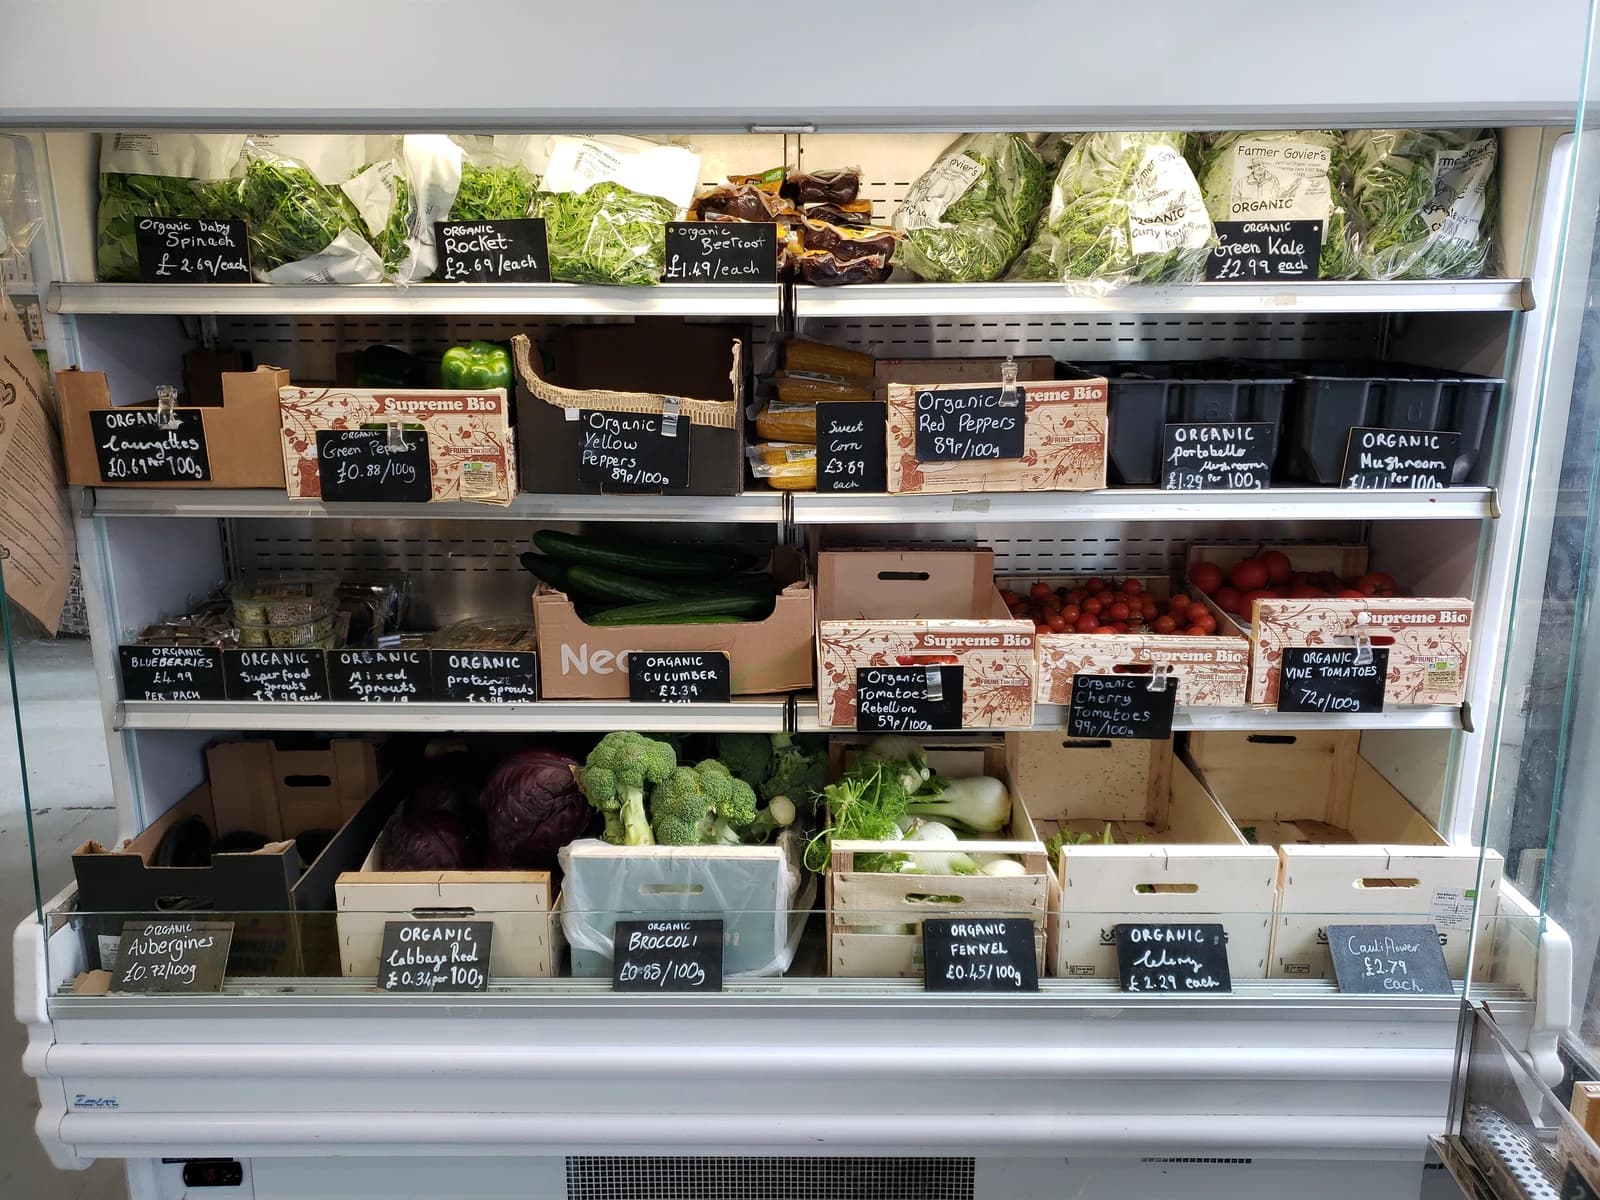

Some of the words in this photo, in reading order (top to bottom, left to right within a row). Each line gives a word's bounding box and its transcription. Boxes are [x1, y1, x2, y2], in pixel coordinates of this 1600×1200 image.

[1238, 145, 1280, 157] Farmer
[1284, 147, 1327, 161] Govier's
[1232, 198, 1294, 213] ORGANIC
[139, 219, 192, 236] Organic
[198, 220, 230, 236] baby
[443, 225, 494, 237] ORGANIC
[678, 225, 730, 241] organic
[1243, 222, 1291, 233] ORGANIC
[166, 231, 236, 249] Spinach
[1214, 234, 1262, 257] Green
[1268, 235, 1305, 255] Kale
[1216, 258, 1270, 279] £2.99
[1278, 259, 1309, 274] each
[1073, 386, 1103, 400] Bio
[384, 398, 463, 412] Supreme
[467, 397, 497, 411] Bio
[918, 392, 996, 414] Organic
[589, 412, 656, 435] Organic
[828, 420, 864, 434] Sweet
[919, 413, 945, 433] Red
[958, 413, 1016, 434] Peppers
[583, 431, 638, 450] Yellow
[1175, 426, 1254, 442] ORGANIC
[1362, 432, 1440, 449] ORGANIC
[322, 439, 361, 459] Green
[829, 440, 863, 453] Corn
[934, 436, 1000, 459] 89p/100g
[582, 450, 636, 469] Peppers
[1360, 452, 1447, 471] Mushroom
[108, 457, 148, 478] £0.69
[166, 456, 202, 479] 100g
[336, 459, 416, 484] £0.88/100g
[611, 467, 669, 485] 89p/100g
[1166, 471, 1203, 489] £1.29
[833, 480, 859, 489] each
[1439, 611, 1468, 623] Bio
[923, 634, 999, 648] Supreme
[1002, 634, 1032, 647] Bio
[152, 648, 205, 658] ORGANIC
[241, 652, 310, 666] ORGANIC
[340, 651, 420, 664] ORGANIC
[1139, 648, 1213, 662] Supreme
[1215, 649, 1243, 662] Bio
[1303, 652, 1352, 665] ORGANIC
[131, 657, 214, 668] BLUEBERRIES
[449, 655, 521, 669] ORGANIC
[646, 656, 704, 668] ORGANIC
[153, 671, 192, 684] £4.99
[349, 668, 407, 682] Mixed
[643, 670, 718, 682] CUCUMBER
[867, 671, 926, 686] Organic
[1285, 667, 1312, 679] VINE
[1319, 665, 1377, 677] TOMATOES
[349, 681, 416, 695] Sprouts
[1077, 676, 1136, 689] Organic
[145, 690, 166, 701] PER
[659, 685, 699, 697] £2.39
[858, 687, 928, 700] Tomatoes
[1075, 690, 1132, 706] Cherry
[861, 701, 917, 714] Rebellion
[1300, 688, 1360, 712] 72p/100g
[1074, 707, 1150, 721] Tomatoes
[143, 924, 193, 936] ORGANIC
[400, 927, 473, 942] ORGANIC
[647, 922, 693, 932] ORGANIC
[950, 923, 1006, 937] ORGANIC
[1130, 928, 1205, 943] ORGANIC
[128, 935, 214, 962] Aubergines
[950, 942, 1008, 957] FENNEL
[1348, 935, 1421, 956] Cauliflower
[386, 946, 447, 973] Cabbage
[450, 941, 478, 963] Red
[122, 961, 197, 985] £0.72/100g
[946, 963, 1021, 986] £0.45/100g
[1363, 957, 1407, 977] £2.79
[450, 966, 484, 989] 100g
[1185, 975, 1220, 989] each
[1381, 976, 1424, 992] each
